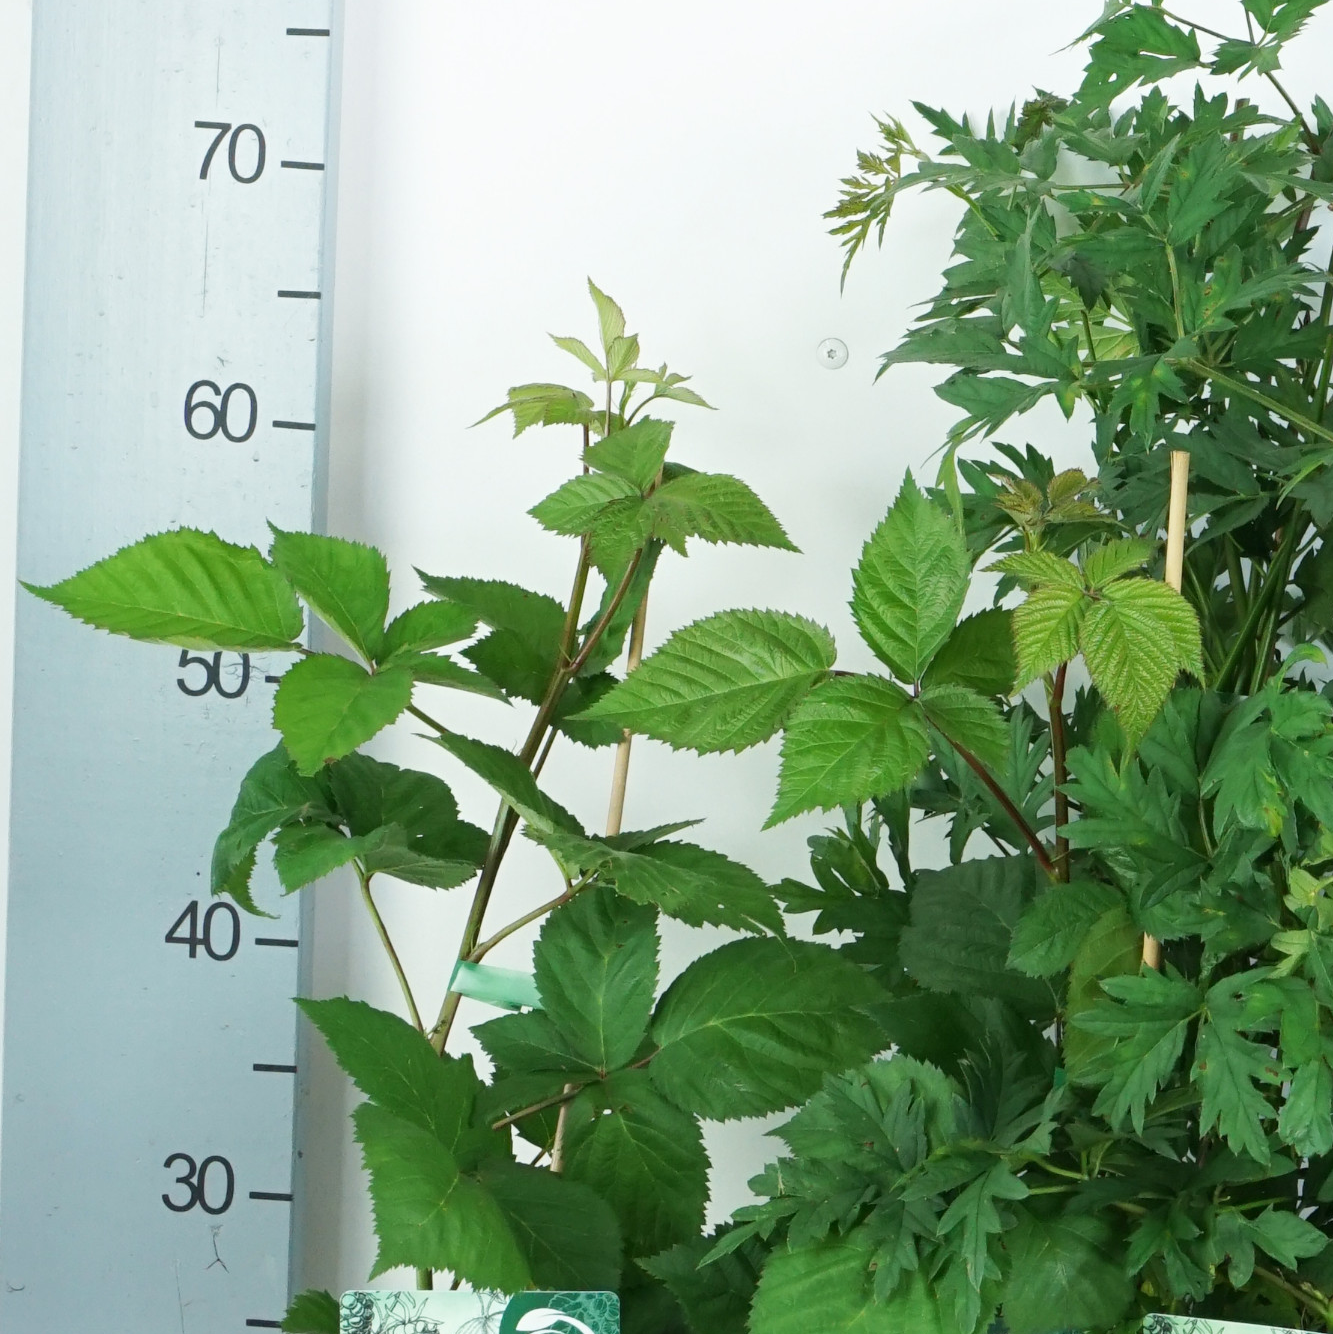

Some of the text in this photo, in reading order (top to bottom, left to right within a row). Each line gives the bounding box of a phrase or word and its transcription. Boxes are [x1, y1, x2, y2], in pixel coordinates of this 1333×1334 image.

[194, 121, 267, 184] 70
[184, 380, 257, 443] 60
[176, 648, 250, 700] 50
[165, 901, 241, 963] 40
[161, 1153, 235, 1216] 30
